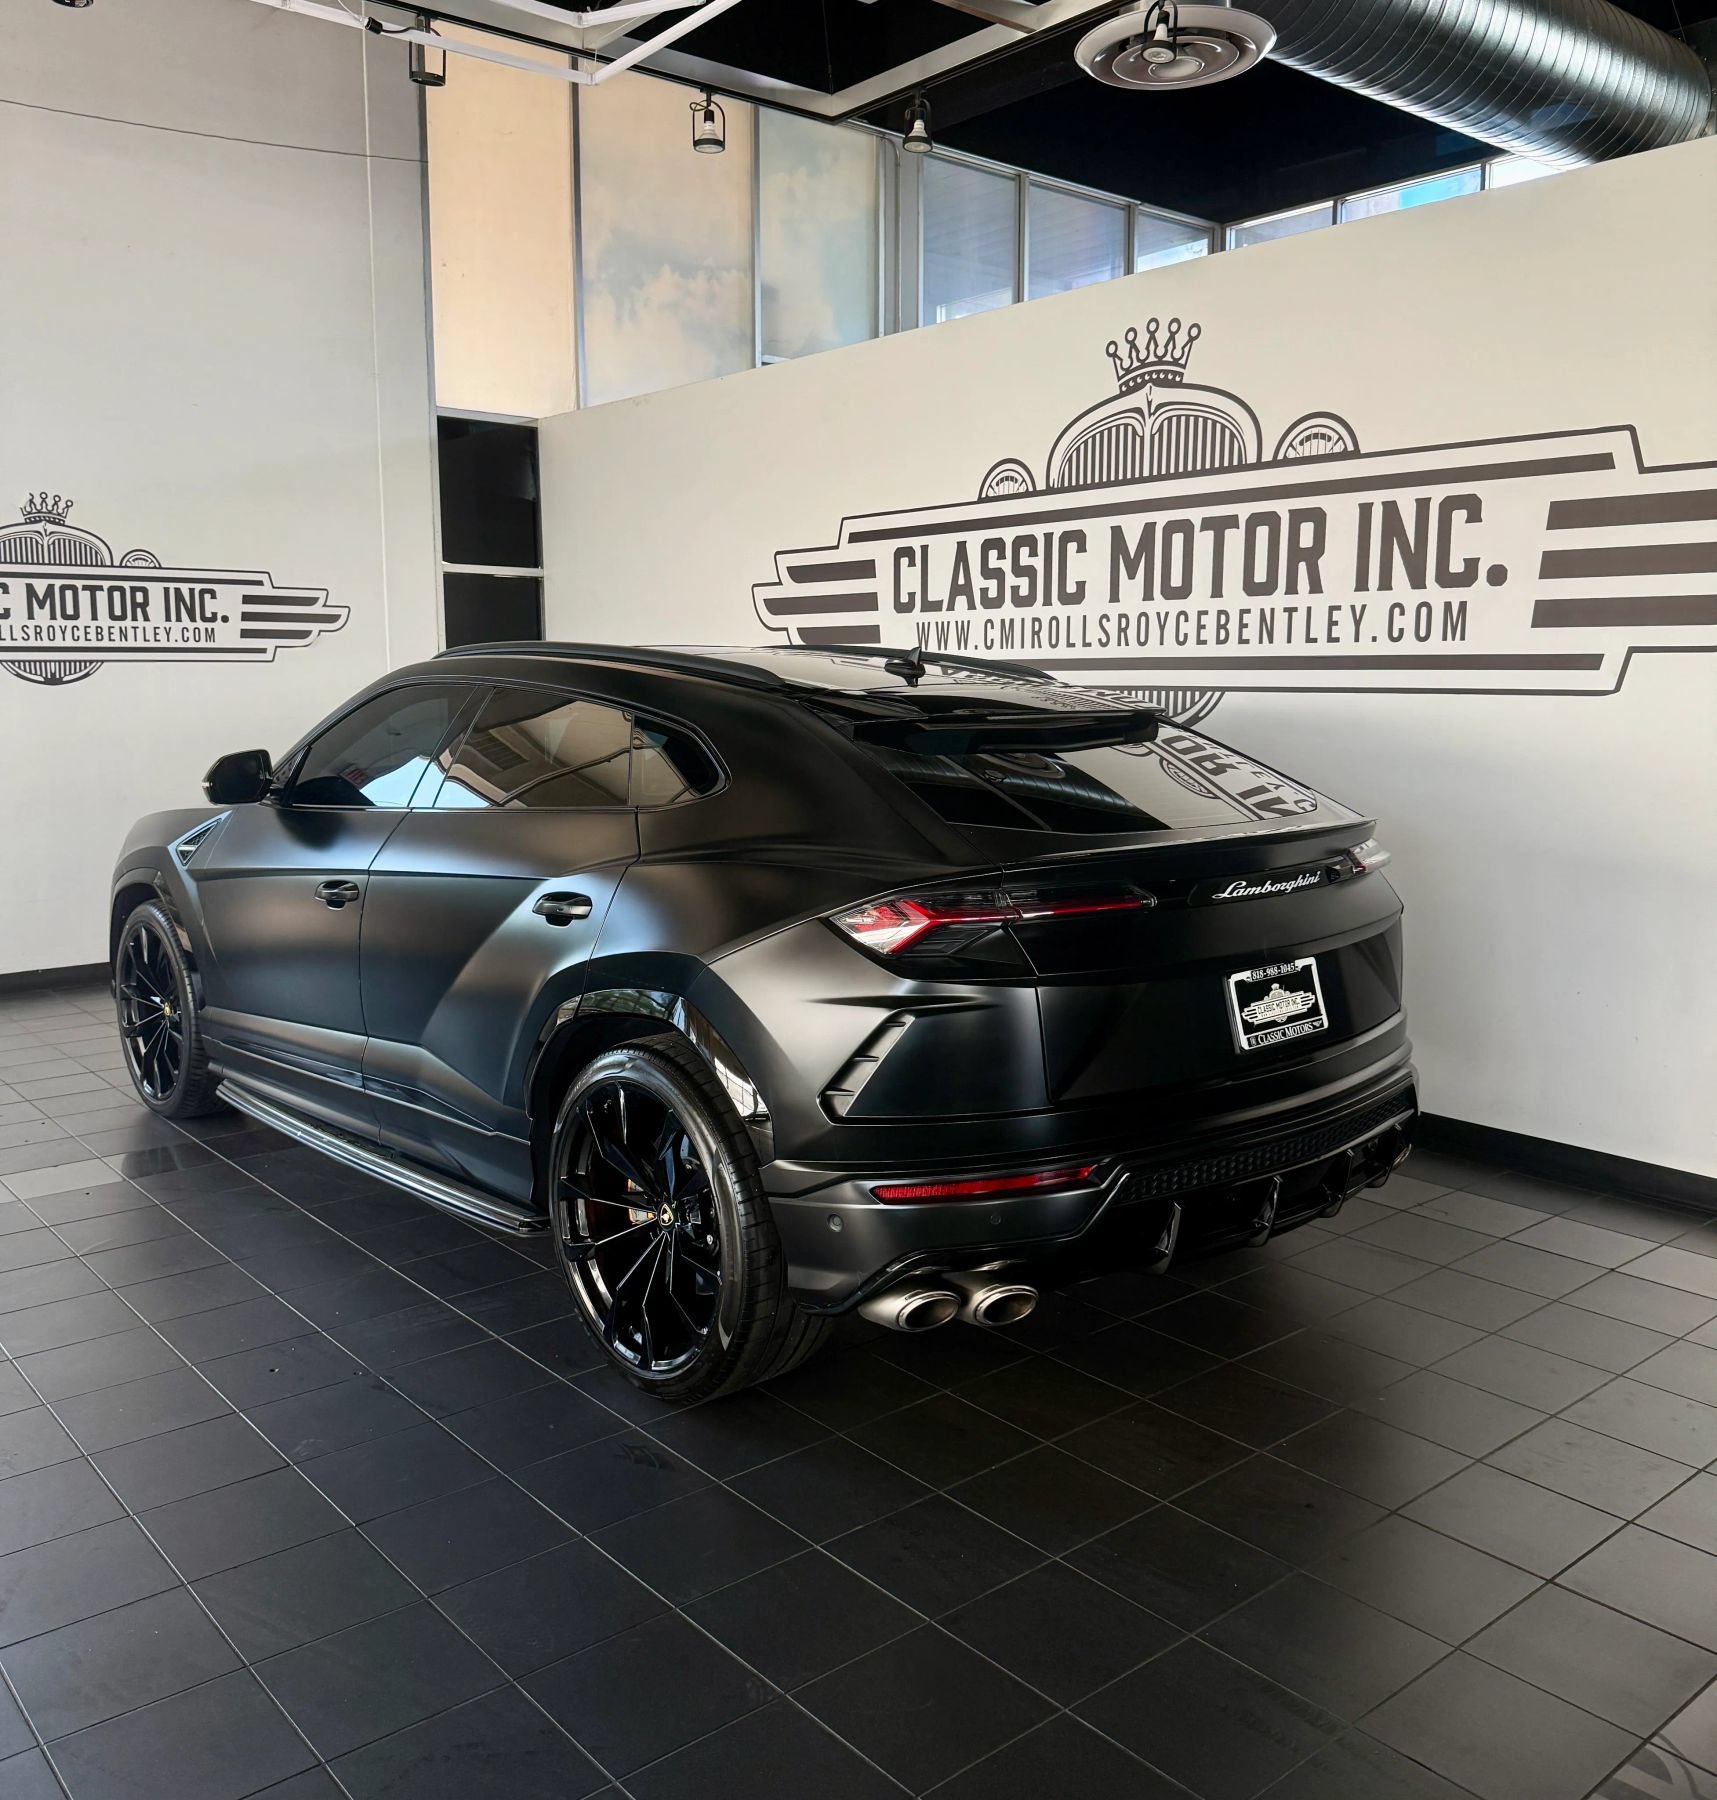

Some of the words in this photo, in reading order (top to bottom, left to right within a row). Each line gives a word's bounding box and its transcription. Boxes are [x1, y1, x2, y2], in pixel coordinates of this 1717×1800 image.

[893, 530, 1087, 614] CLASSIC
[1108, 507, 1327, 604] MOTOR
[1354, 493, 1508, 592] INC.
[25, 582, 151, 622] MOTOR
[163, 586, 230, 624] INC.
[916, 601, 1468, 651] WWW.CMIROLLSROYCEBENTLEY.COM
[1212, 871, 1321, 899] Lamborghini
[1252, 963, 1295, 980] 818-988-1045
[1258, 1029, 1285, 1045] CLASSIC
[1285, 1022, 1314, 1038] MOTORS
